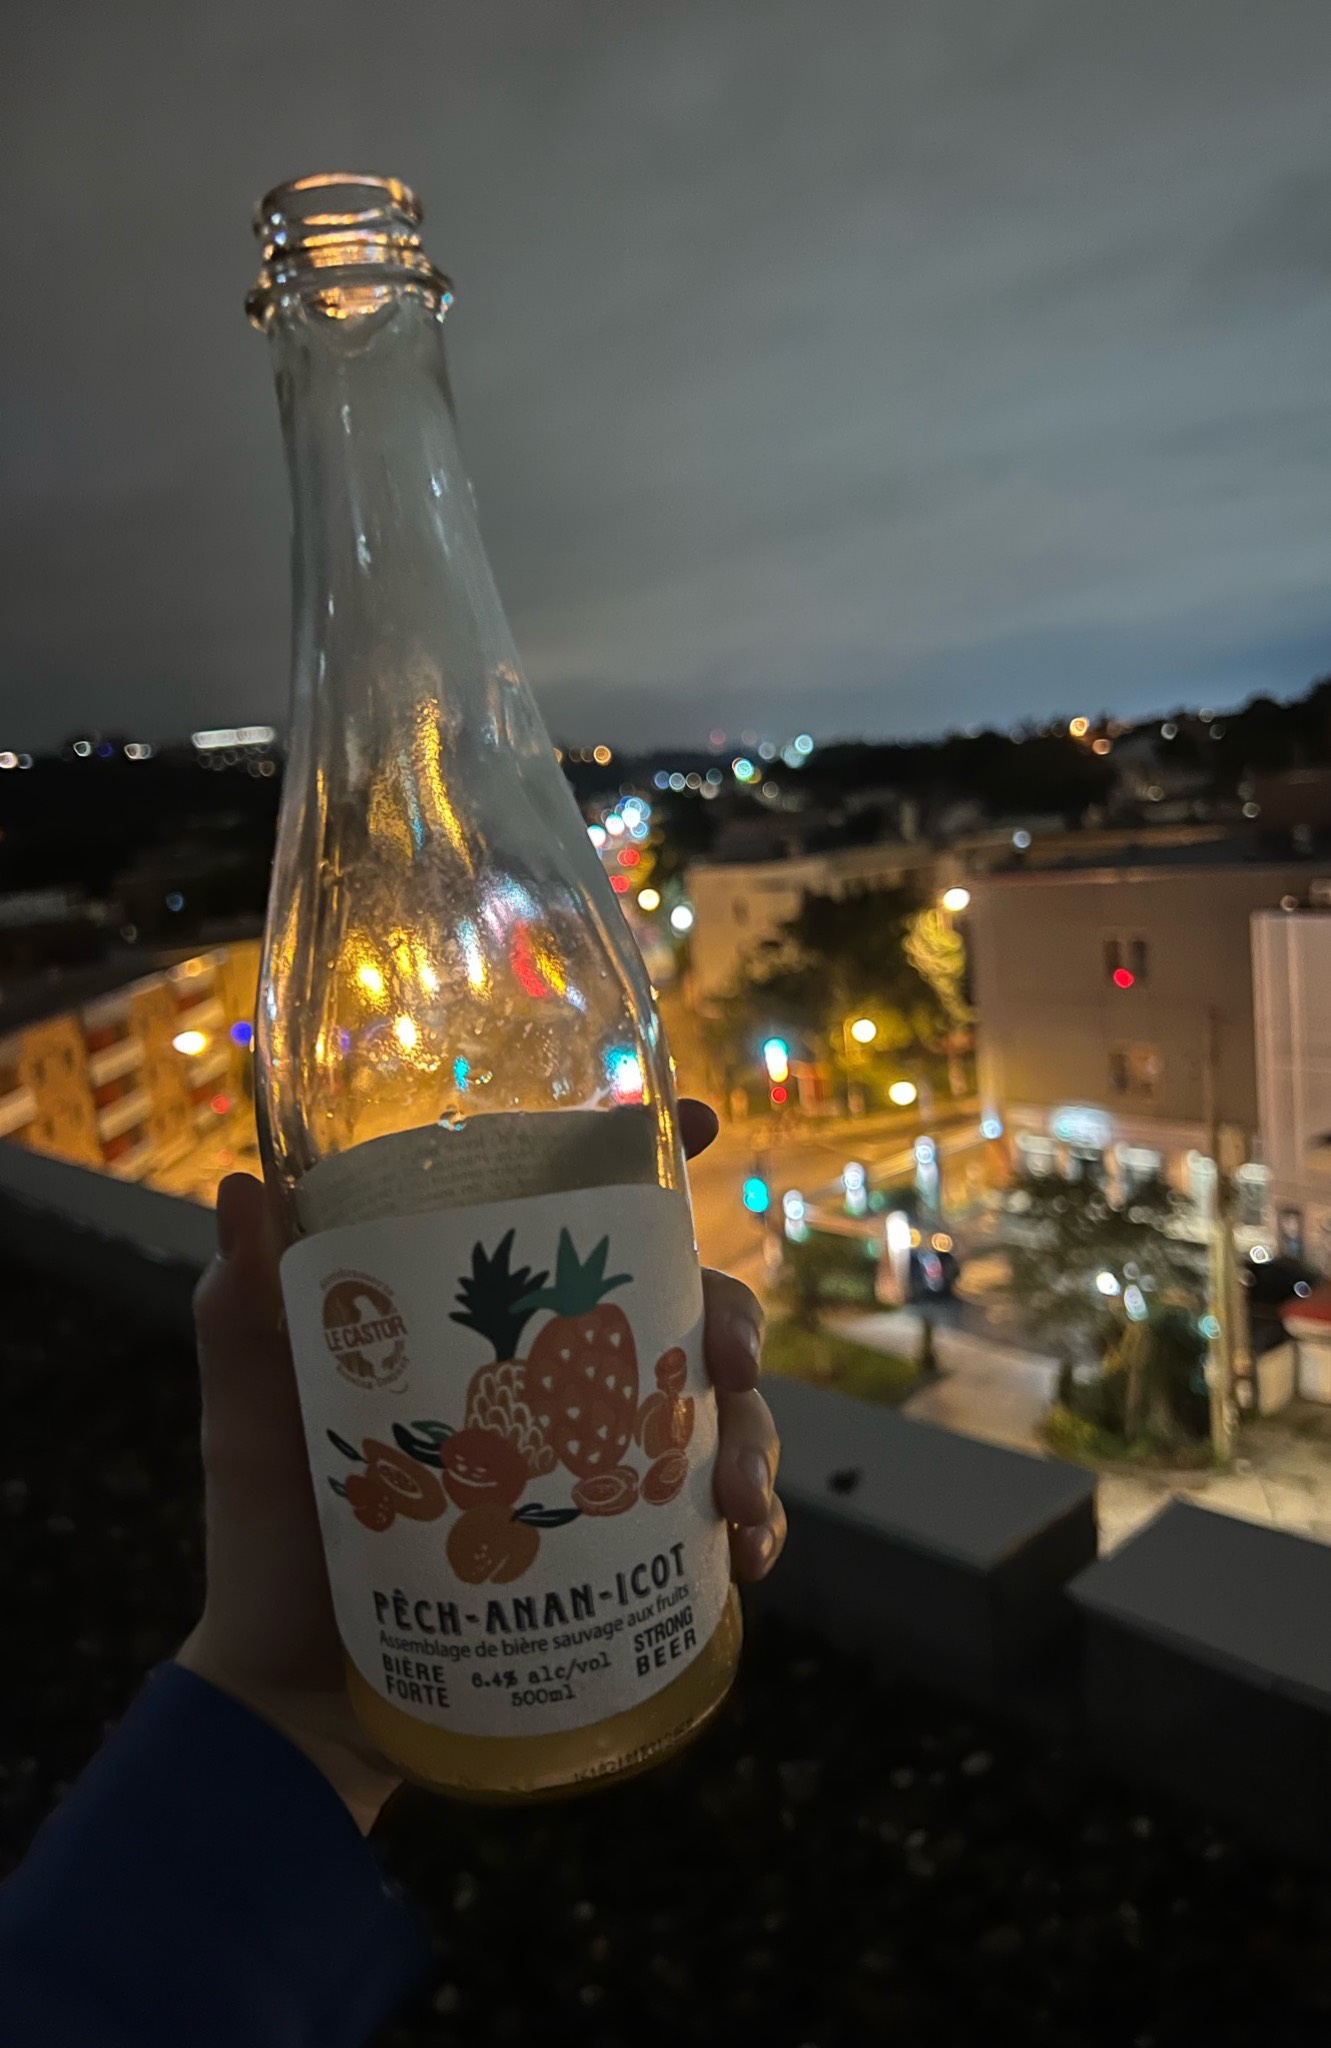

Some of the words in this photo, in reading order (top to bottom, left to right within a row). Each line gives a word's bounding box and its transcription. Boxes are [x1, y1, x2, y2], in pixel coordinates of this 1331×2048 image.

[325, 1331, 343, 1351] LE
[343, 1315, 408, 1347] CASTOR
[373, 1542, 686, 1636] PÊCH-ANAN-ICOT
[379, 1630, 470, 1662] Assemblage
[475, 1640, 497, 1657] de
[502, 1633, 549, 1656] bière
[554, 1620, 624, 1653] sauvage
[627, 1607, 655, 1628] aux
[656, 1584, 689, 1614] fruits
[634, 1605, 694, 1653] STRONG
[383, 1654, 445, 1683] BIÈRE
[472, 1670, 517, 1688] 6.4%
[528, 1652, 612, 1683] alc/vol
[636, 1628, 697, 1676] BEER
[387, 1676, 450, 1708] FORTE
[511, 1684, 576, 1708] 500ml
